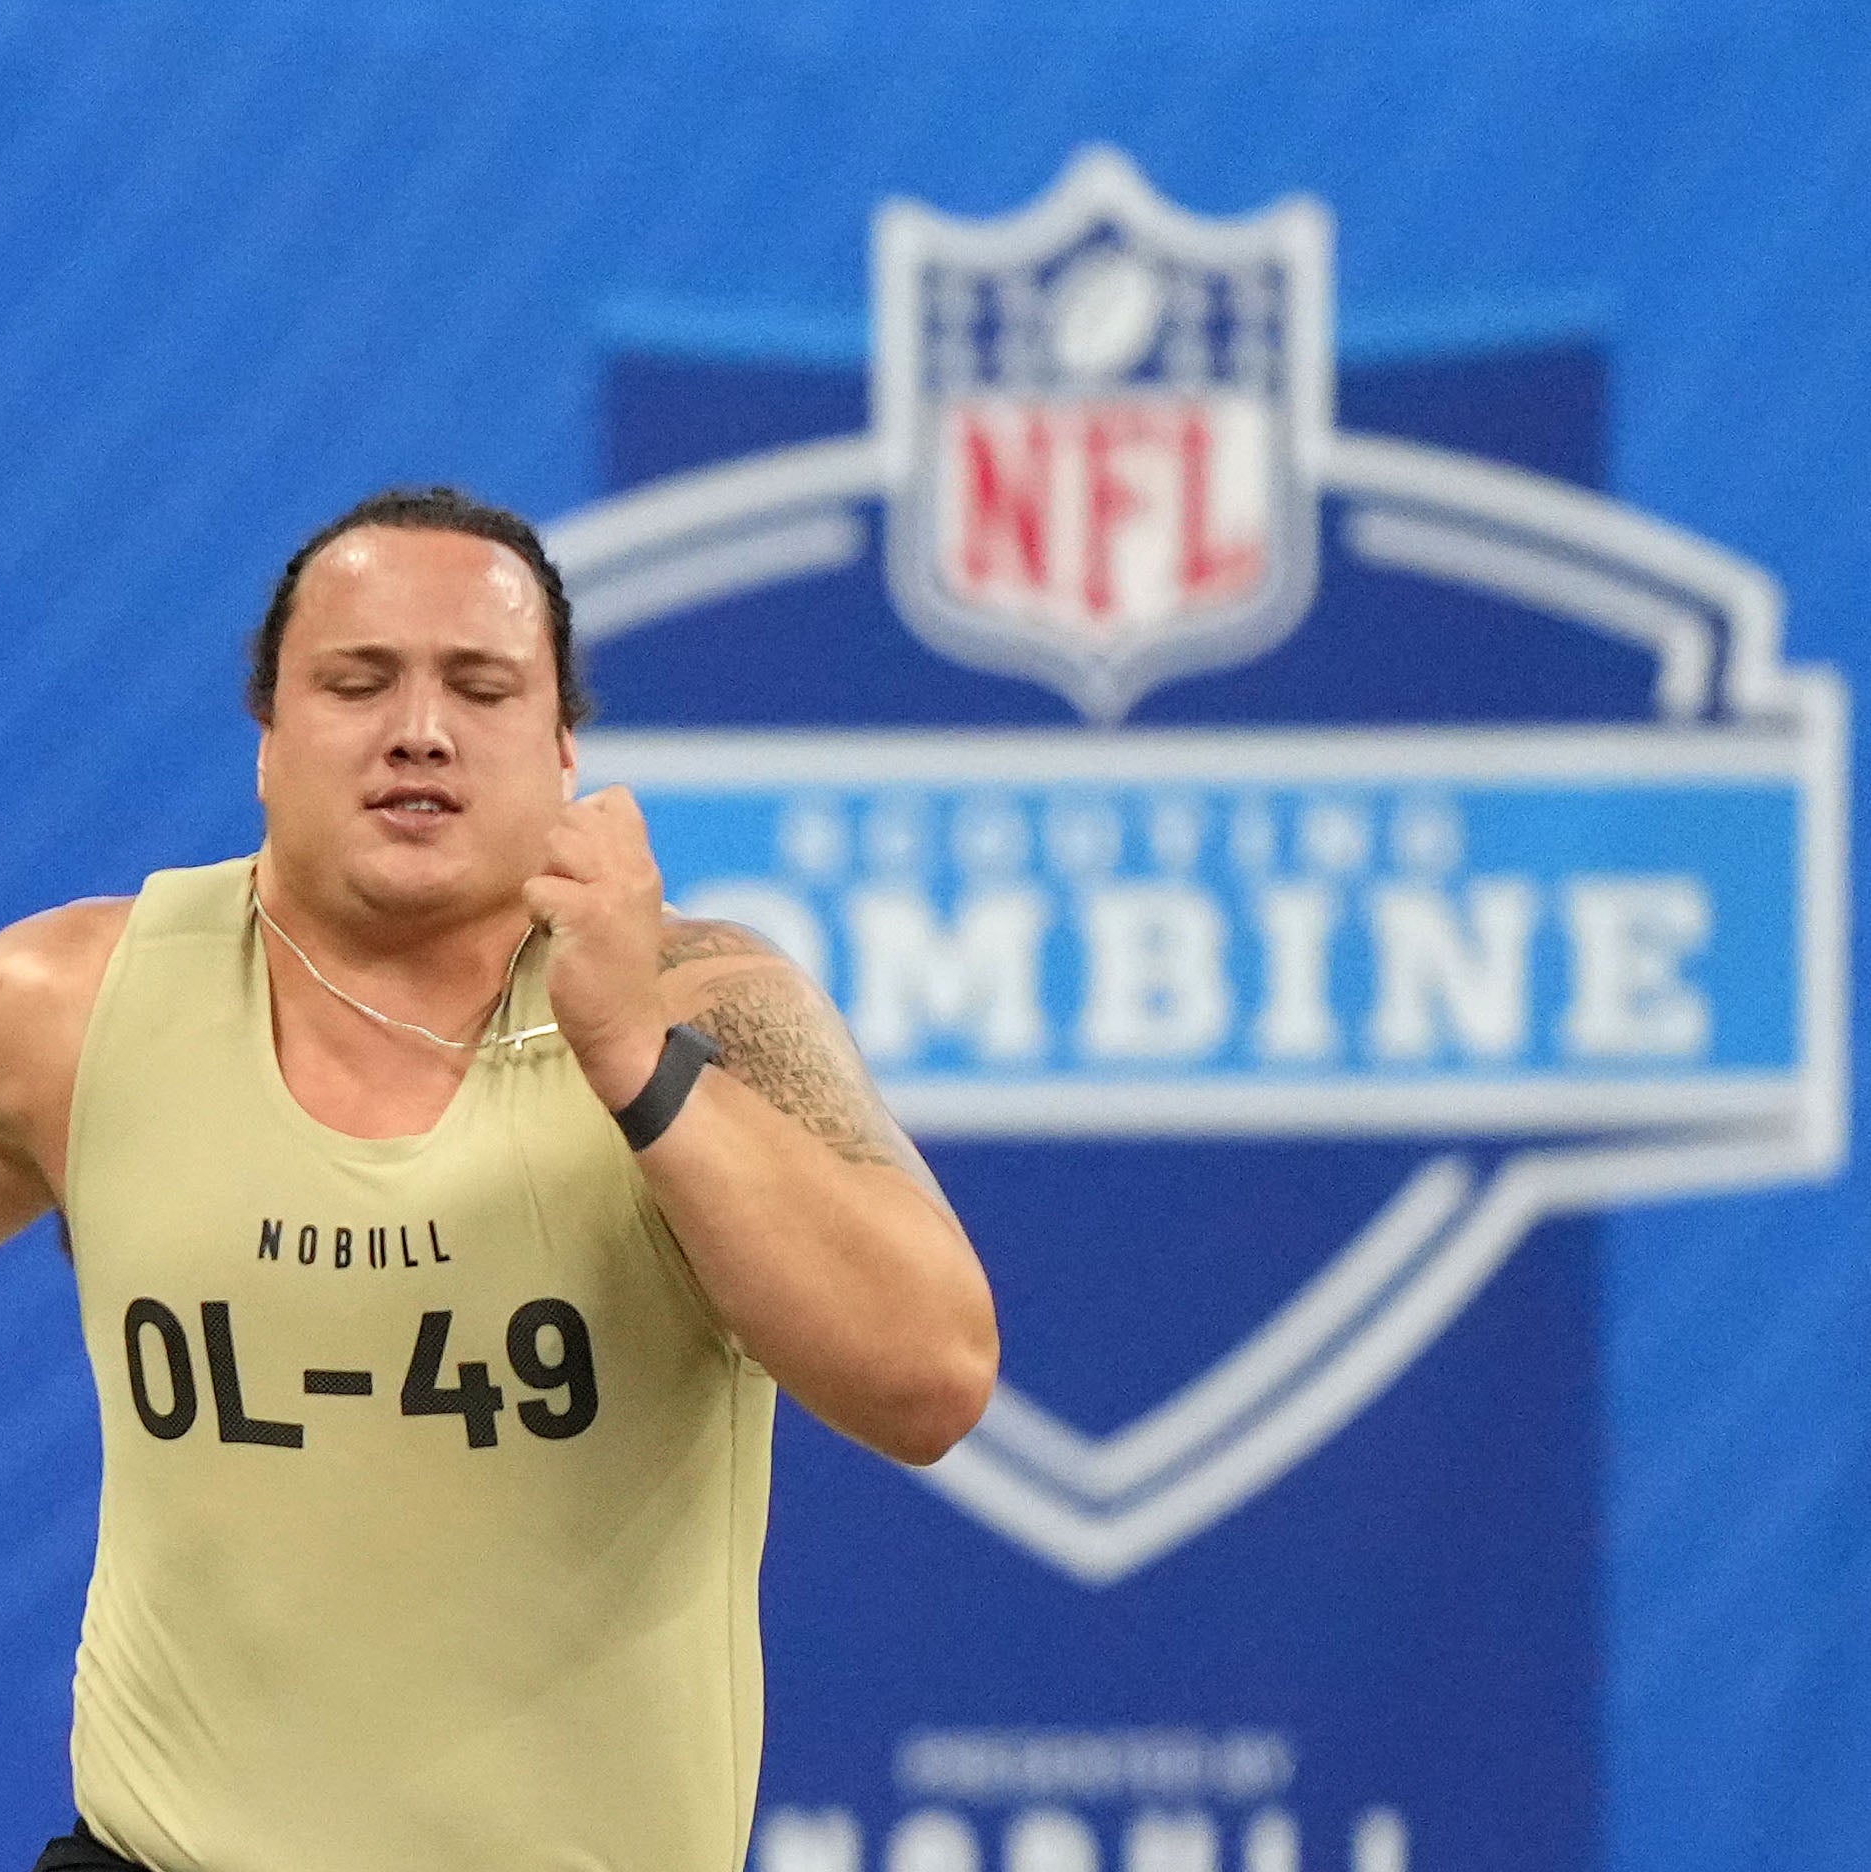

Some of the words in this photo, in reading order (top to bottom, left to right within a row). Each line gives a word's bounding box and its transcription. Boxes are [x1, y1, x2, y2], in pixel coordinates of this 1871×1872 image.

[949, 402, 1269, 618] NFL
[674, 874, 1713, 1064] MBINE
[259, 1218, 451, 1269] NOBULL
[124, 1296, 600, 1449] OL-49
